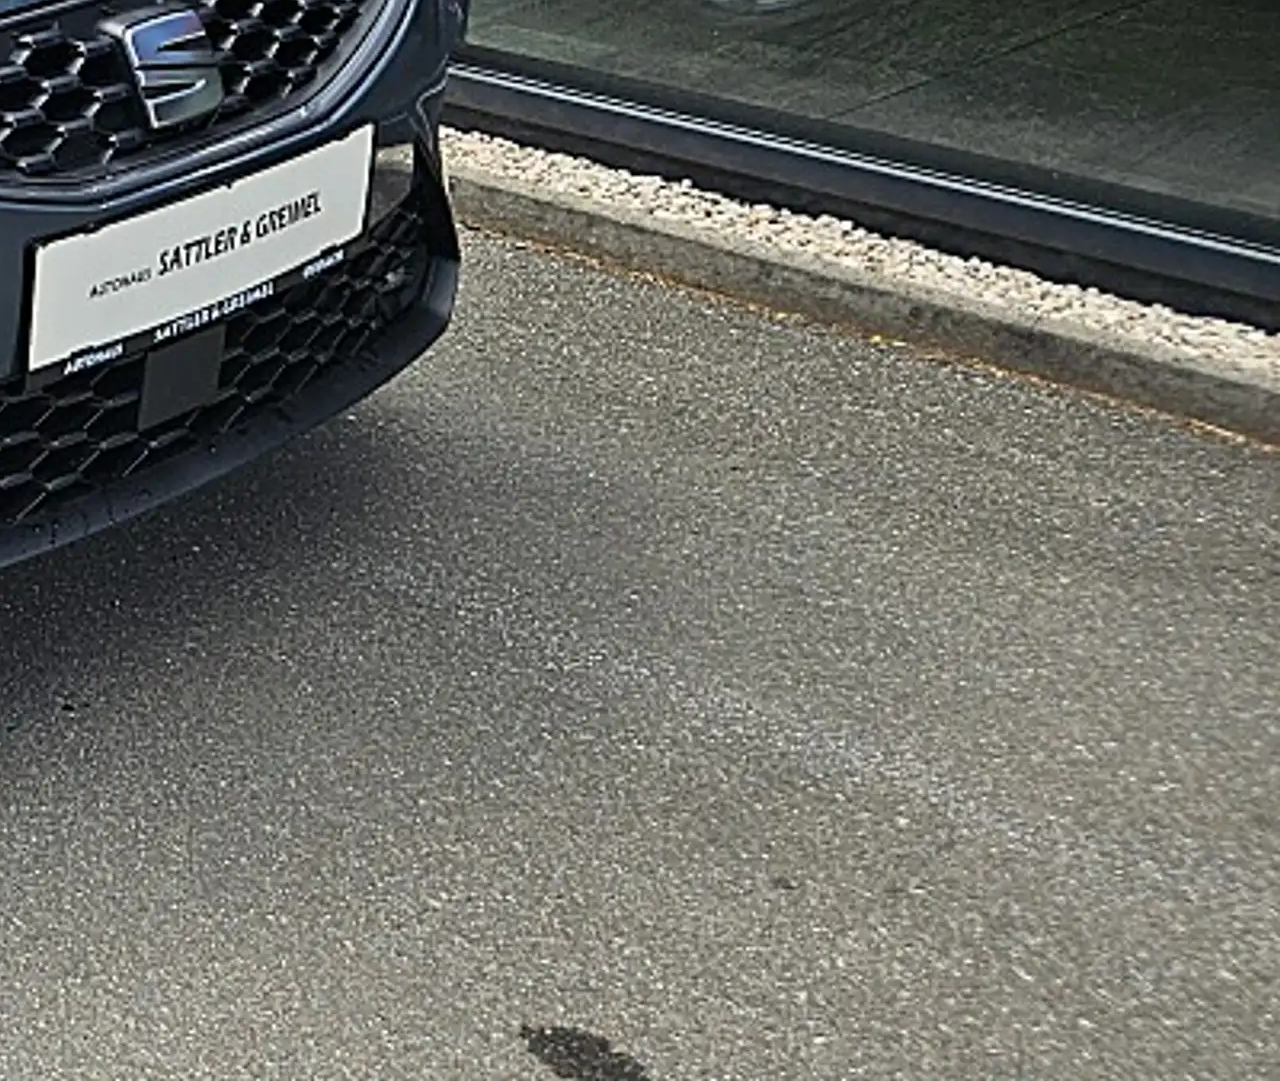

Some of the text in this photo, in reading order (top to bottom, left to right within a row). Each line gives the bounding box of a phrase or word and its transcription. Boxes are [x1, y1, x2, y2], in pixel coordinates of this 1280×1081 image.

[88, 190, 323, 299] AUTOHAUS SATTLER & GREIMEL
[152, 308, 210, 344] SATTLER
